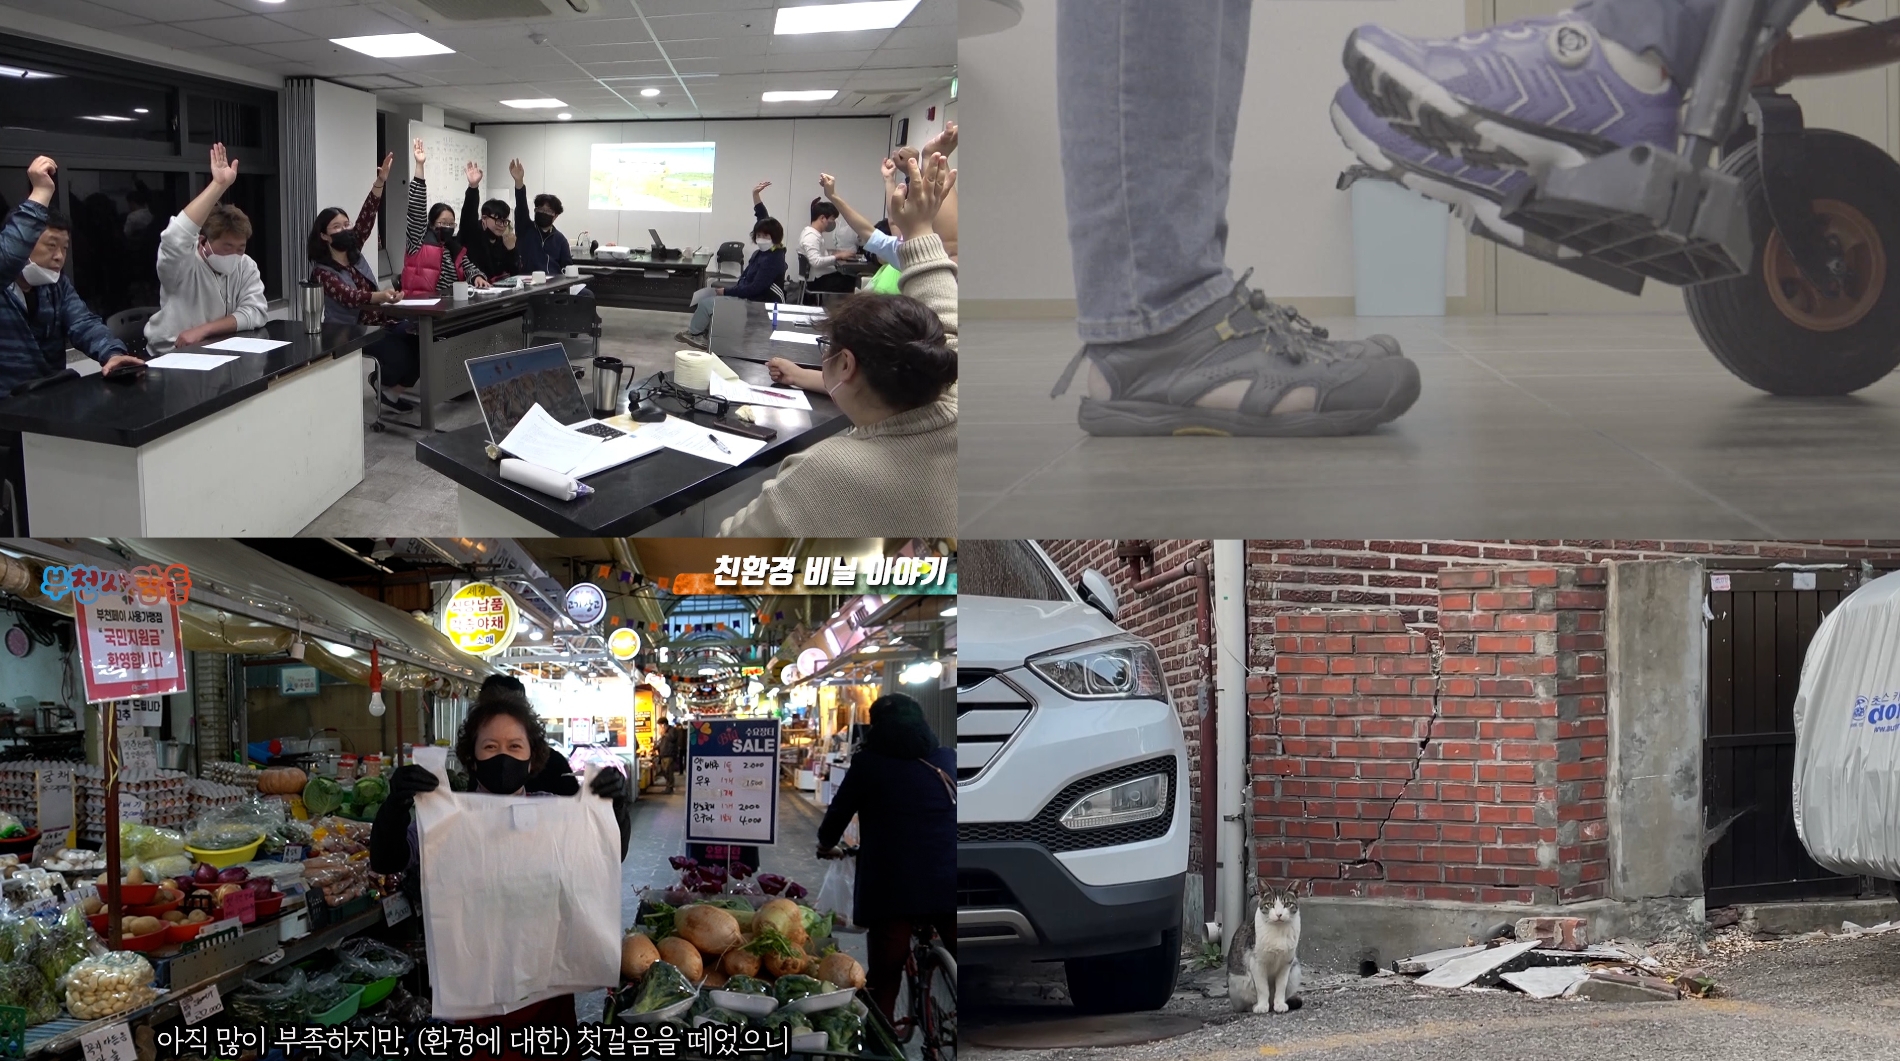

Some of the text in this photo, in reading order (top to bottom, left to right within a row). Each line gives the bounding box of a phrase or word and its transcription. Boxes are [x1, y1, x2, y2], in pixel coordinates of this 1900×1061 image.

[96, 608, 127, 622] 부천페이
[106, 651, 163, 670] 환영합니다
[1868, 703, 1900, 725] do
[745, 727, 775, 738] 수요장터
[732, 738, 776, 753] SALE
